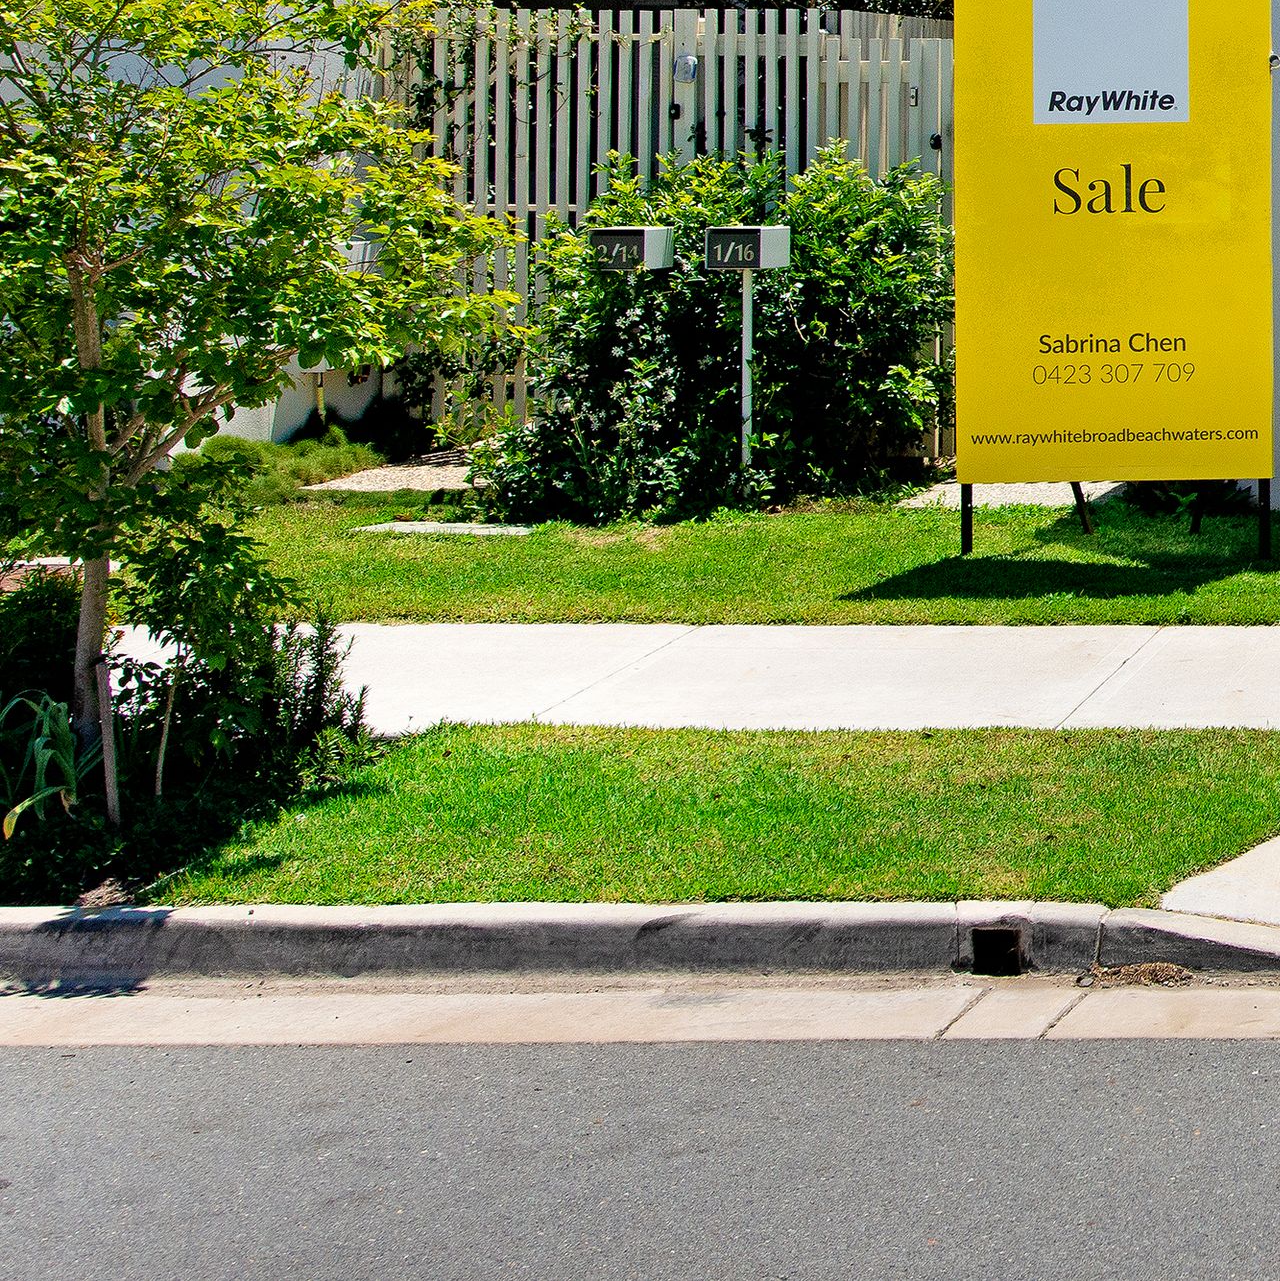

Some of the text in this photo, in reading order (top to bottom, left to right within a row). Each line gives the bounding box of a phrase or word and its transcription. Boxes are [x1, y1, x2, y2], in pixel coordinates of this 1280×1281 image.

[1053, 163, 1166, 215] Sale
[597, 243, 639, 264] 2/14
[713, 241, 755, 263] 1/16
[1038, 332, 1186, 354] Sabrina Chen
[1032, 362, 1196, 385] 0423 307 709
[970, 427, 1259, 447] www.raywhitebroadbeachwaters.com
